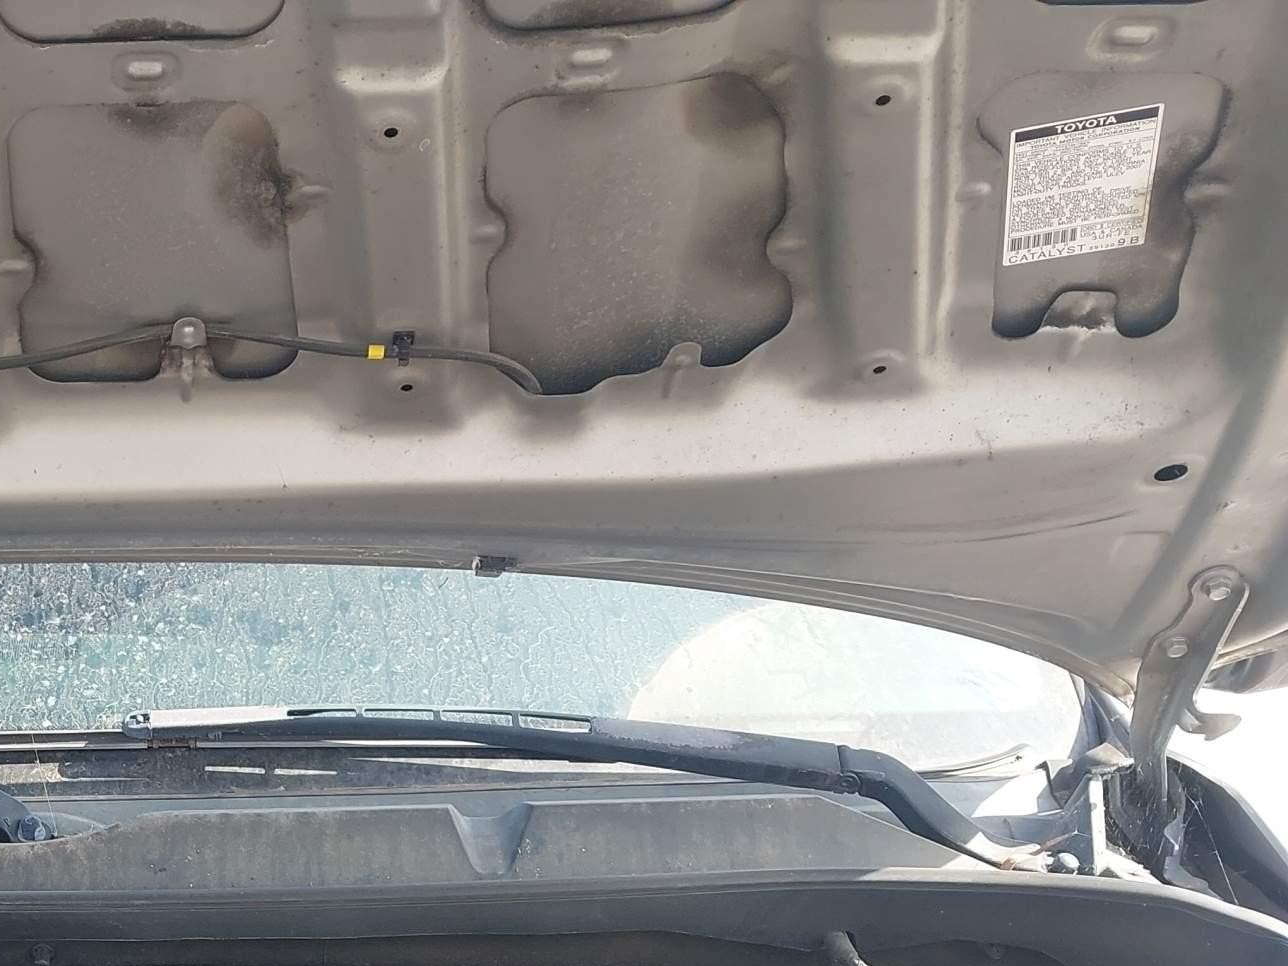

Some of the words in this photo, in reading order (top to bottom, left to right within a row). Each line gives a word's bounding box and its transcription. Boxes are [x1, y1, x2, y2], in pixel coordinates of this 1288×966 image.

[1016, 135, 1060, 148] IMPORTANT
[1101, 118, 1157, 132] INFORMATION
[1054, 115, 1118, 135] TOYOTA
[1008, 243, 1086, 264] CATALYST
